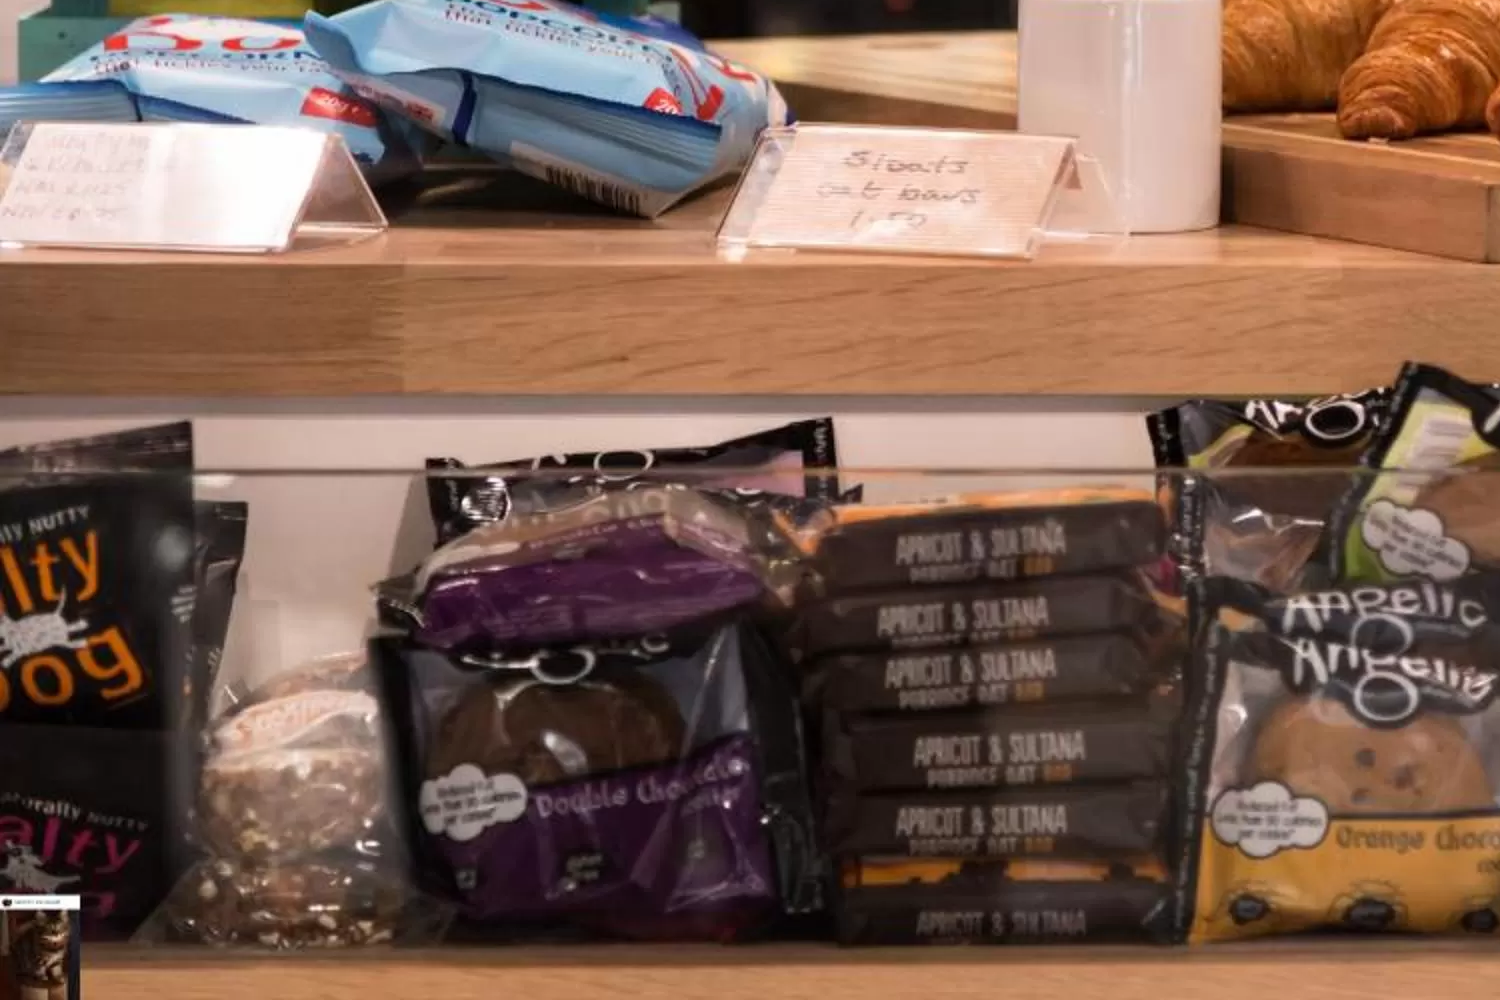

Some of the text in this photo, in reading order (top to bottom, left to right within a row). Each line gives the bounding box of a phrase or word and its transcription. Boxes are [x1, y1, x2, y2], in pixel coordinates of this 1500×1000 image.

[28, 504, 91, 531] NUTTY
[895, 519, 1067, 565] APRICOT & SULTANA
[0, 529, 99, 613] lty
[876, 596, 1050, 639] APRICOT & SULTANA
[1282, 583, 1487, 652] Angelic
[0, 626, 147, 707] og
[884, 648, 1057, 689] APRICOT & SULTANA
[1283, 634, 1497, 722] Angelic
[913, 730, 1087, 768] APRICOT & SULTANA
[895, 804, 1070, 838] APRICOT & SULTANA
[1335, 825, 1427, 853] Orange
[0, 815, 142, 874] alty
[915, 909, 985, 937] APRICOT
